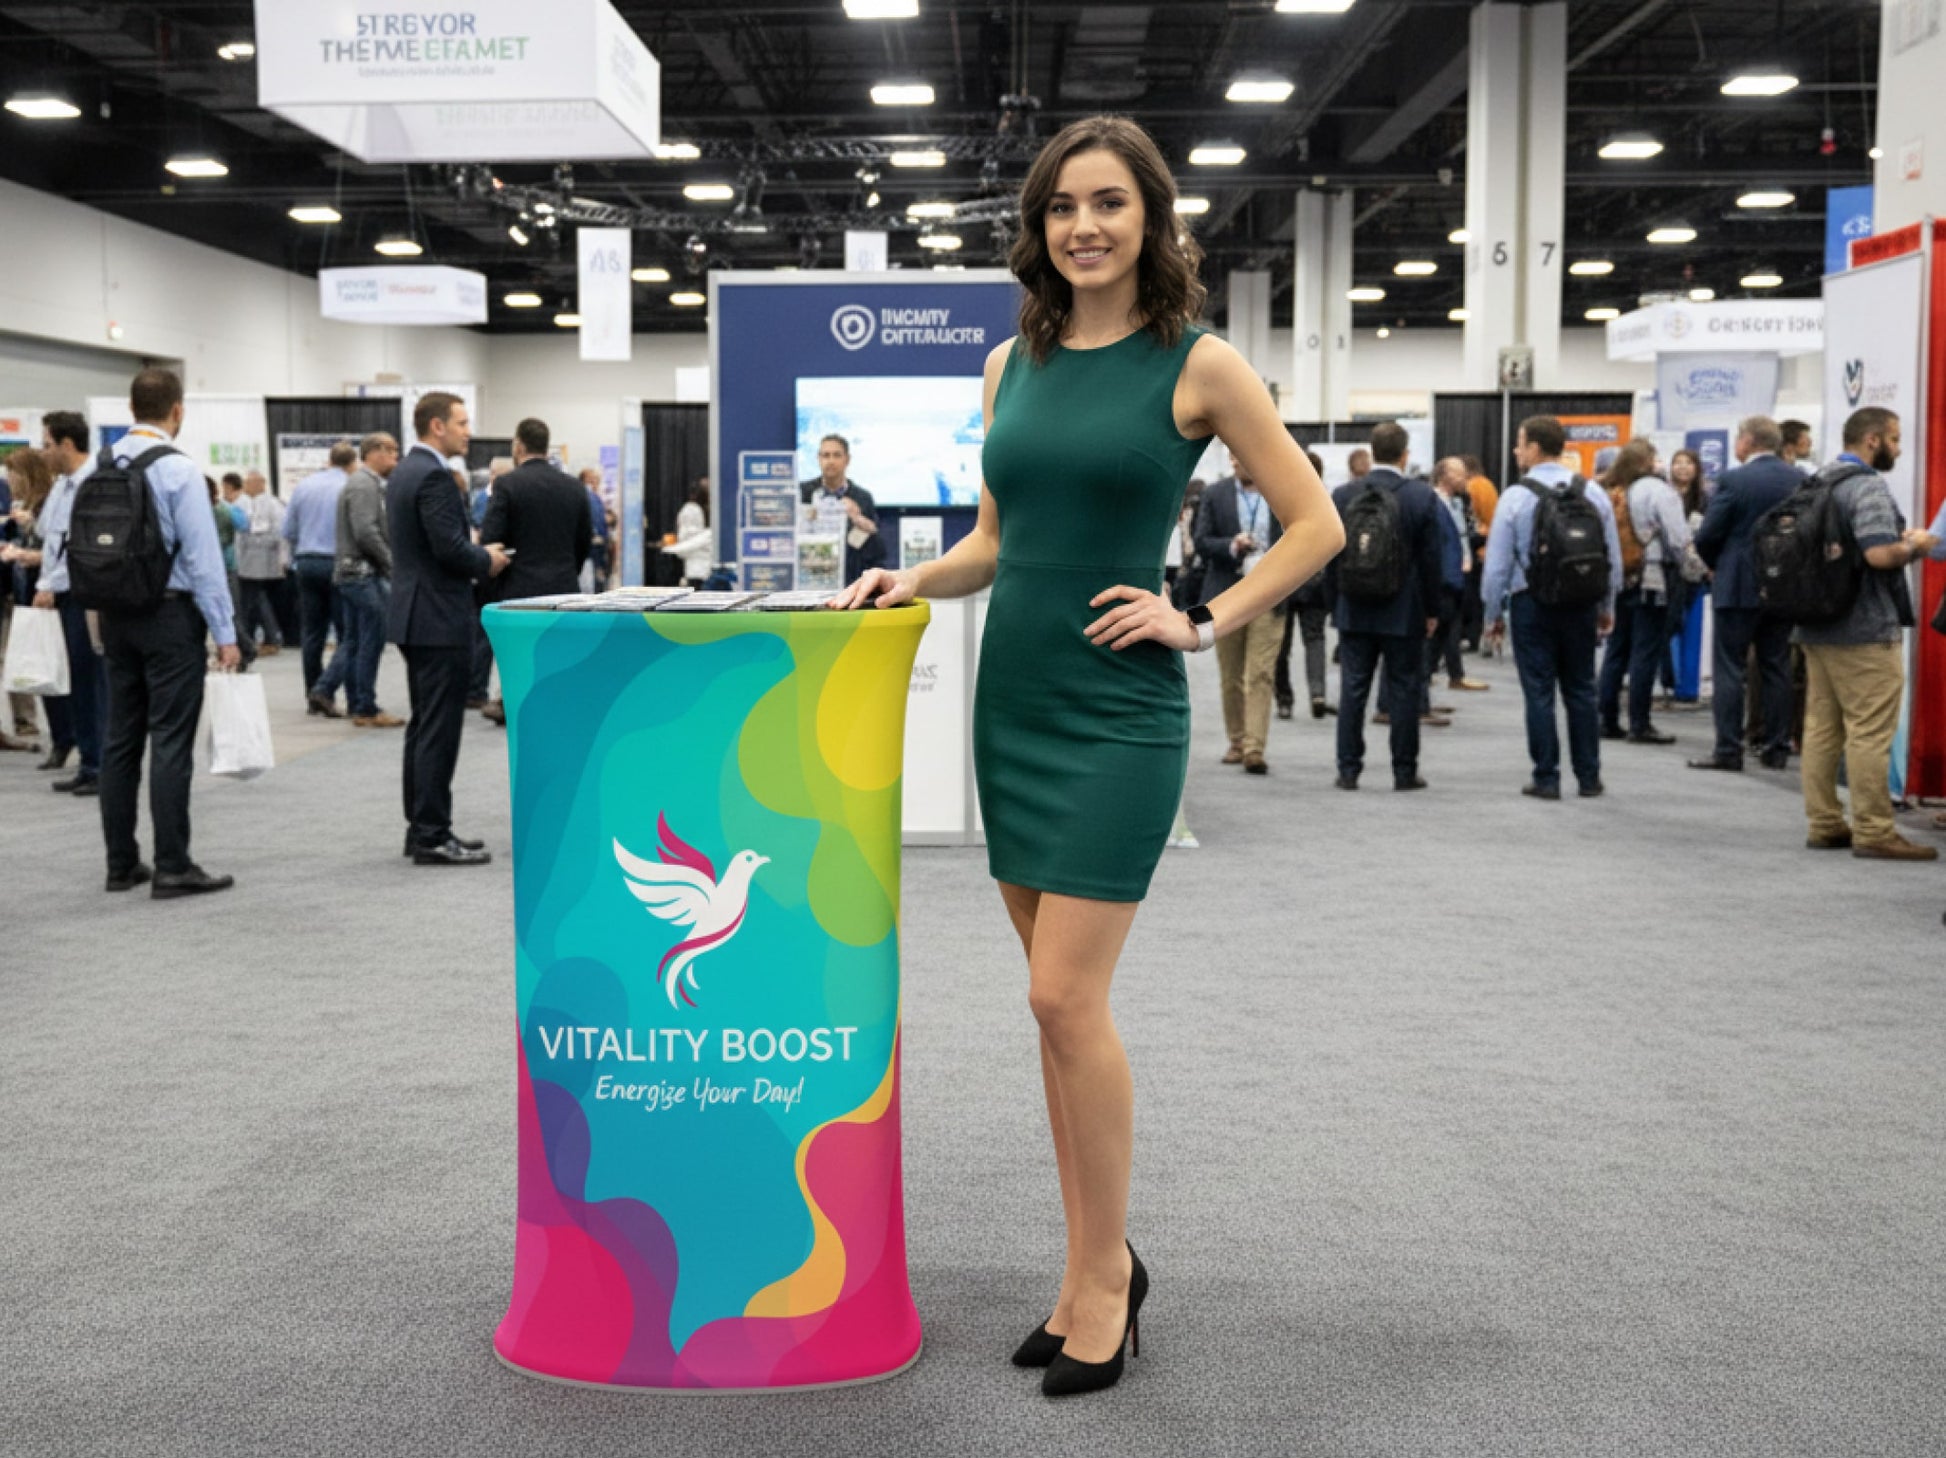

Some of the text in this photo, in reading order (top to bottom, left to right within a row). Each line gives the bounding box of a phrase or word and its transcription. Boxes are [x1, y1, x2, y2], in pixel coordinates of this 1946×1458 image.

[1540, 242, 1556, 266] 7
[538, 1026, 858, 1062] VITALITY BOOST
[595, 1075, 804, 1113] Energize Your Day!
